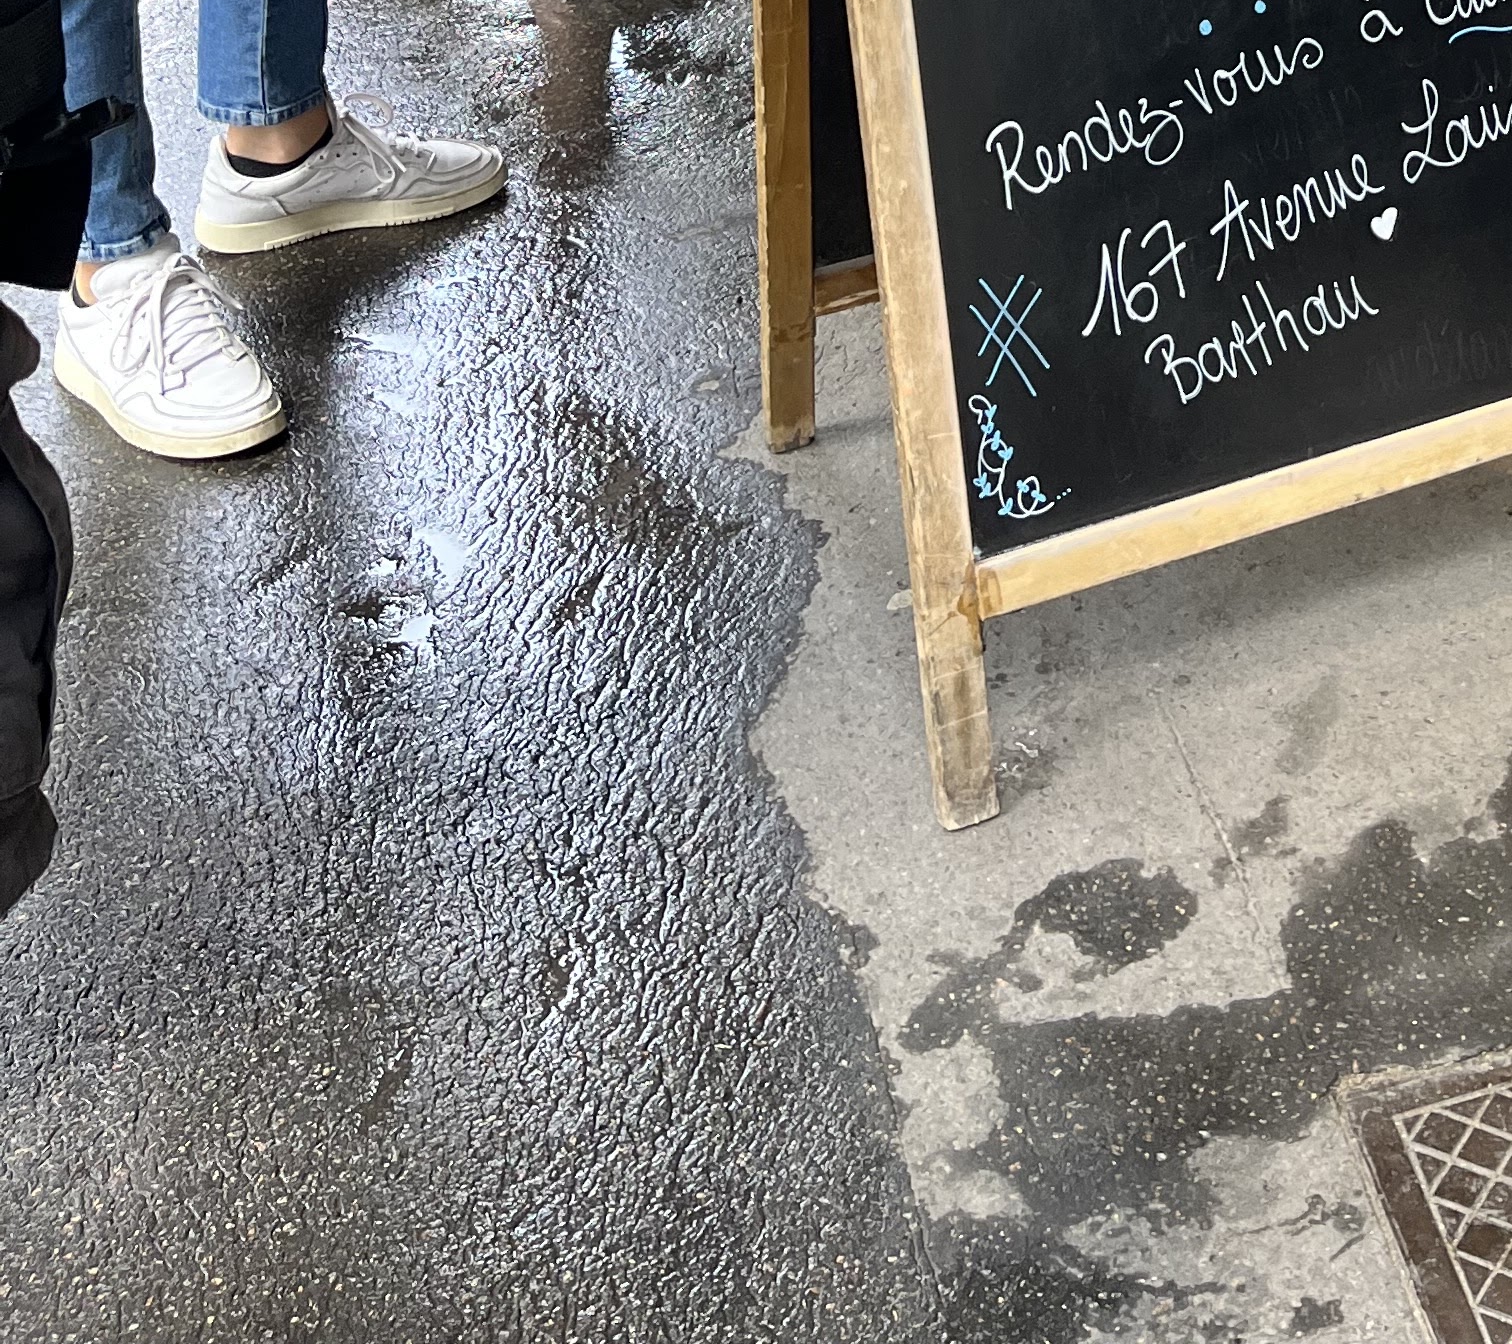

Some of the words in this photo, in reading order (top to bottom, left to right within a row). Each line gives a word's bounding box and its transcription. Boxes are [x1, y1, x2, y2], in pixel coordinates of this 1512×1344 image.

[984, 35, 1325, 211] Rendez-vous
[1080, 219, 1188, 339] 167
[1209, 153, 1386, 282] Avenue
[1145, 276, 1379, 406] Barthou
